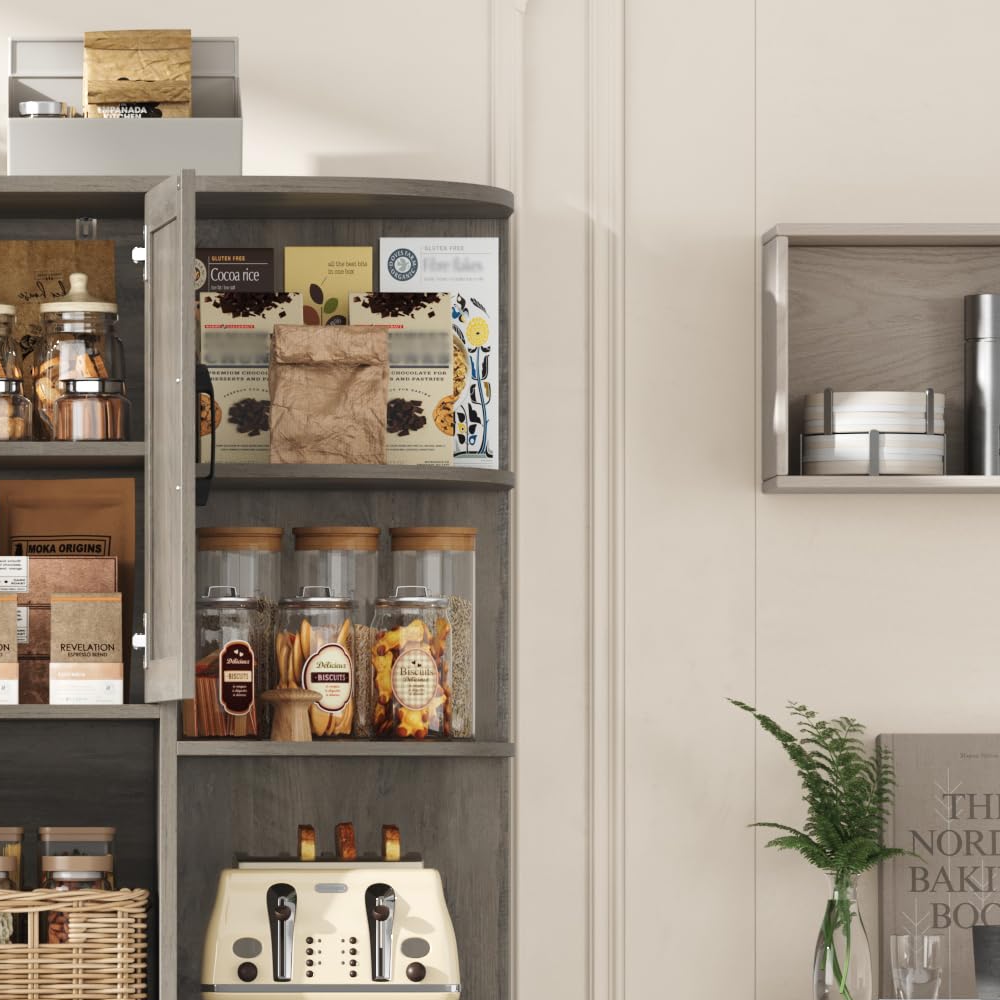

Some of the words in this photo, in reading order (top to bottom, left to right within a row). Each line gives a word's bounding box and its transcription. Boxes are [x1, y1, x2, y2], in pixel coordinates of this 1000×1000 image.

[210, 267, 240, 282] Cocoa
[242, 267, 260, 282] rice
[28, 544, 56, 553] MOKA
[58, 543, 102, 553] ORIGINS
[60, 643, 115, 652] REVELATION
[400, 666, 434, 676] Biscuits
[942, 793, 1000, 820] TH
